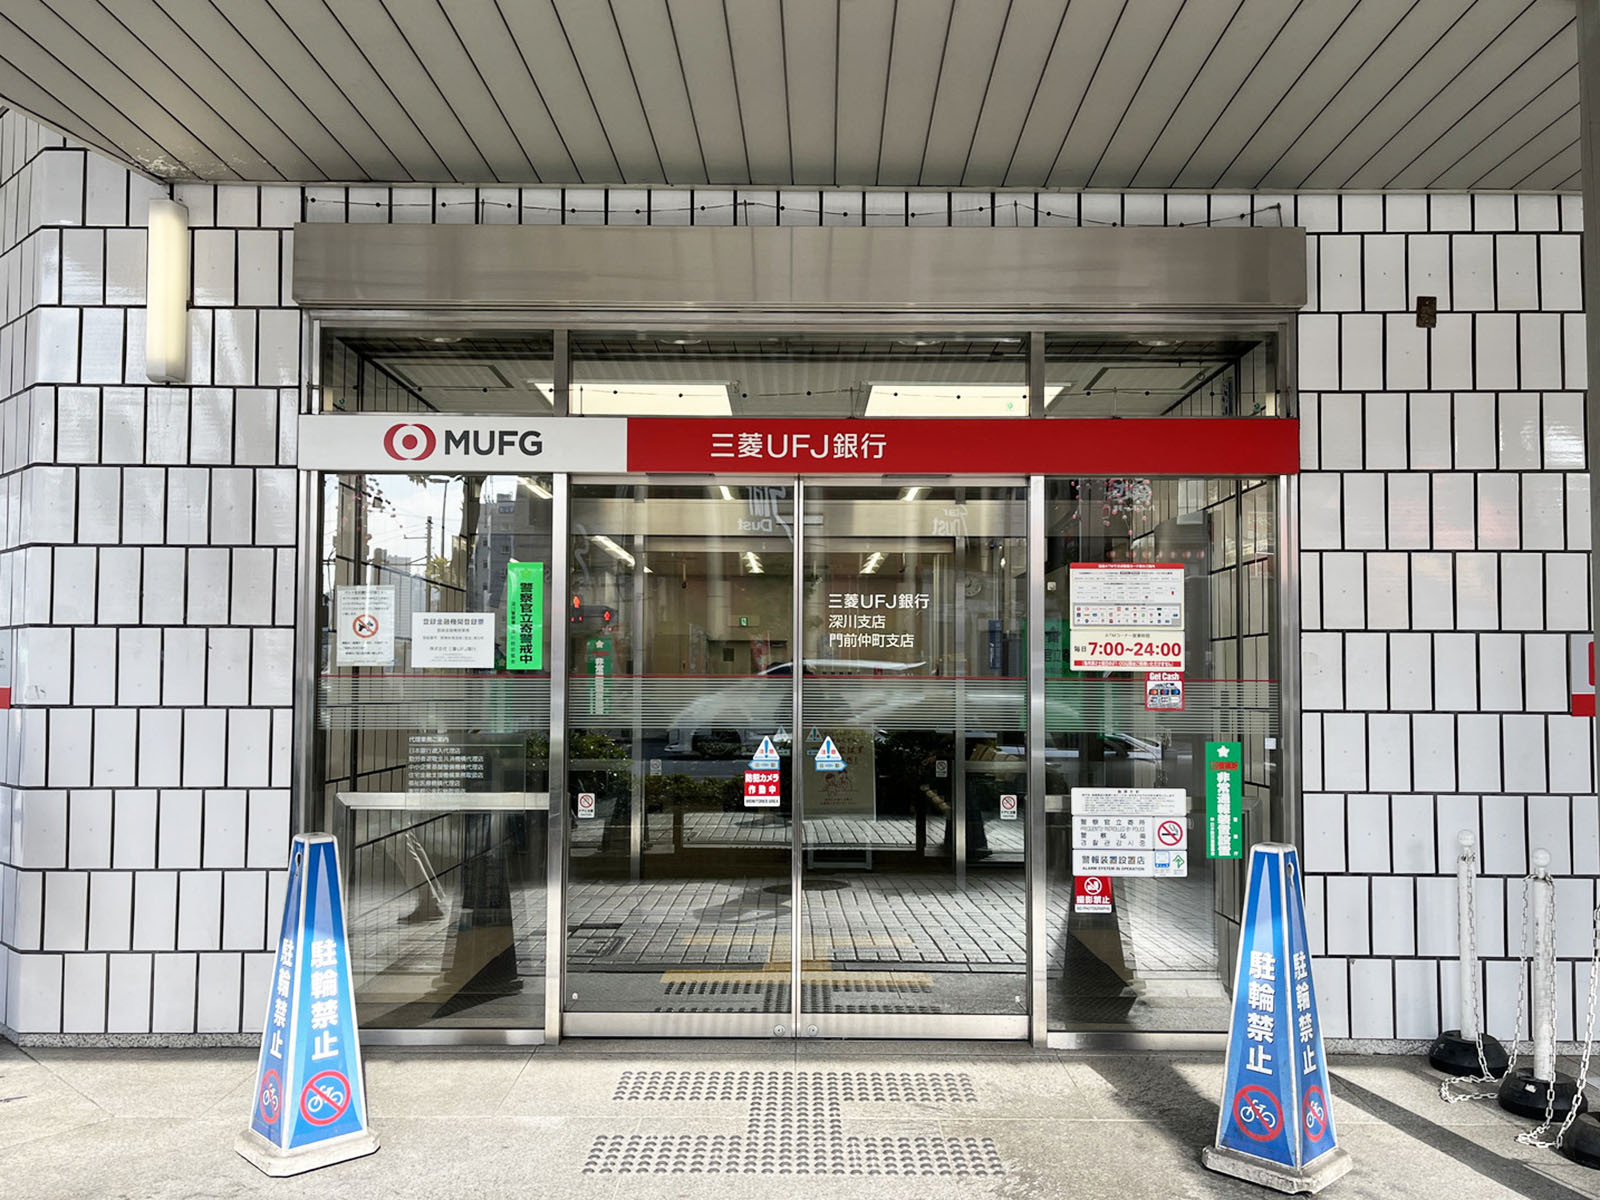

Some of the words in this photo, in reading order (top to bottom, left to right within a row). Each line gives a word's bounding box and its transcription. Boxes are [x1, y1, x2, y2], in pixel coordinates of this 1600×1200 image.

[445, 430, 542, 457] MUFG
[710, 432, 887, 459] 三菱UFJ銀行
[828, 593, 930, 609] 三菱UFJ銀行
[519, 582, 533, 664] 警察官立寄警戒中
[828, 614, 886, 629] 深川支店
[829, 633, 915, 648] 門前仲町支店
[1149, 672, 1161, 681] Get
[1162, 672, 1180, 681] Cash
[744, 773, 780, 783] 防犯カメラ
[748, 784, 777, 794] 作動中
[1081, 855, 1145, 865] 警報装置設置店
[1076, 895, 1111, 904] 撮影禁止
[270, 937, 295, 1060] 駐輪禁止
[310, 937, 339, 1061] 駐輪禁止
[1246, 950, 1277, 1076] 駐輪禁止
[1292, 950, 1318, 1076] 駐輪禁止
